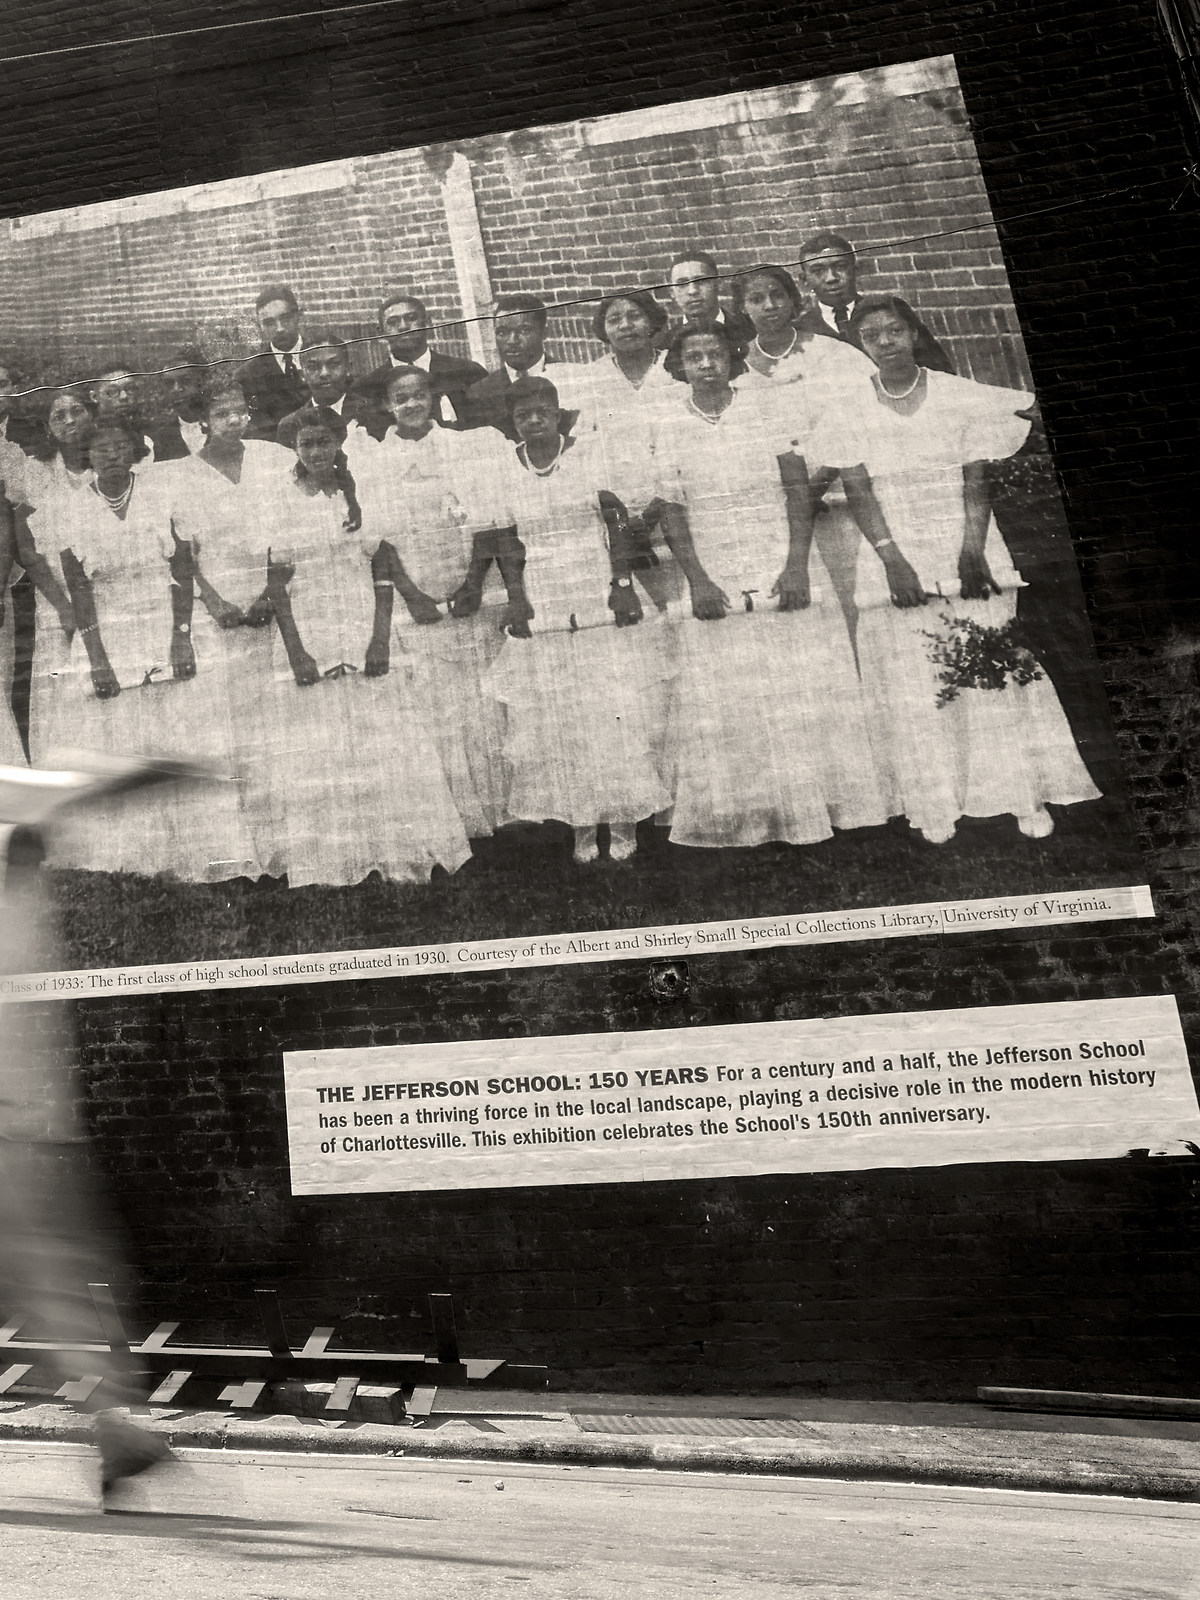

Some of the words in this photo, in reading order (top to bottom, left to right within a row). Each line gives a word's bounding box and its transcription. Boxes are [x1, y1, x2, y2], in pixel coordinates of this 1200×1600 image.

[1, 979, 32, 993] Class
[36, 978, 50, 991] of
[52, 974, 84, 990] 1933:
[87, 972, 114, 988] The
[117, 970, 144, 986] first
[147, 968, 176, 984] class
[179, 966, 194, 982] of
[196, 964, 224, 984] high
[228, 960, 268, 979] school
[272, 958, 325, 976] students
[329, 952, 393, 975] graduated
[396, 952, 410, 967] in
[414, 948, 450, 966] 1930.
[457, 944, 518, 967] Courtesy
[521, 942, 537, 958] of
[539, 940, 562, 956] the
[565, 937, 611, 954] Albert
[614, 934, 640, 951] and
[644, 930, 693, 953] Shirley
[695, 926, 737, 944] Small
[741, 922, 792, 943] Special
[795, 915, 877, 936] Collections
[880, 911, 939, 932] Library,
[943, 903, 1019, 926] University
[1023, 901, 1040, 917] of
[1042, 895, 1112, 916] Virginia.
[317, 1087, 354, 1103] THE
[362, 1080, 479, 1101] JEFFERSON
[487, 1075, 581, 1094] SCHOOL:
[589, 1072, 628, 1089] 150
[635, 1067, 708, 1086] YEARS
[717, 1066, 744, 1081] For
[752, 1068, 761, 1079] a
[769, 1061, 834, 1078] century
[843, 1056, 875, 1073] and
[883, 1059, 893, 1071] a
[900, 1052, 940, 1071] half,
[948, 1051, 978, 1067] the
[986, 1047, 1072, 1065] Jefferson
[1079, 1040, 1145, 1059] School
[319, 1114, 347, 1128] has
[354, 1112, 393, 1126] been
[400, 1113, 409, 1124] a
[416, 1107, 479, 1125] thriving
[484, 1105, 527, 1120] force
[535, 1103, 549, 1118] in
[556, 1101, 583, 1116] the
[591, 1098, 631, 1114] local
[638, 1095, 731, 1112] landscape,
[740, 1089, 803, 1110] playing
[809, 1090, 819, 1102] a
[827, 1083, 899, 1101] decisive
[907, 1080, 941, 1096] role
[948, 1078, 965, 1094] in
[972, 1076, 1003, 1092] the
[1010, 1073, 1082, 1090] modern
[1089, 1069, 1155, 1086] history
[321, 1137, 336, 1153] of
[343, 1133, 466, 1152] Charlottesville.
[472, 1130, 506, 1146] This
[513, 1127, 595, 1144] exhibition
[603, 1122, 693, 1140] celebrates
[700, 1119, 728, 1135] the
[736, 1114, 810, 1133] School's
[818, 1110, 871, 1128] 150th
[880, 1107, 990, 1125] anniversary.
